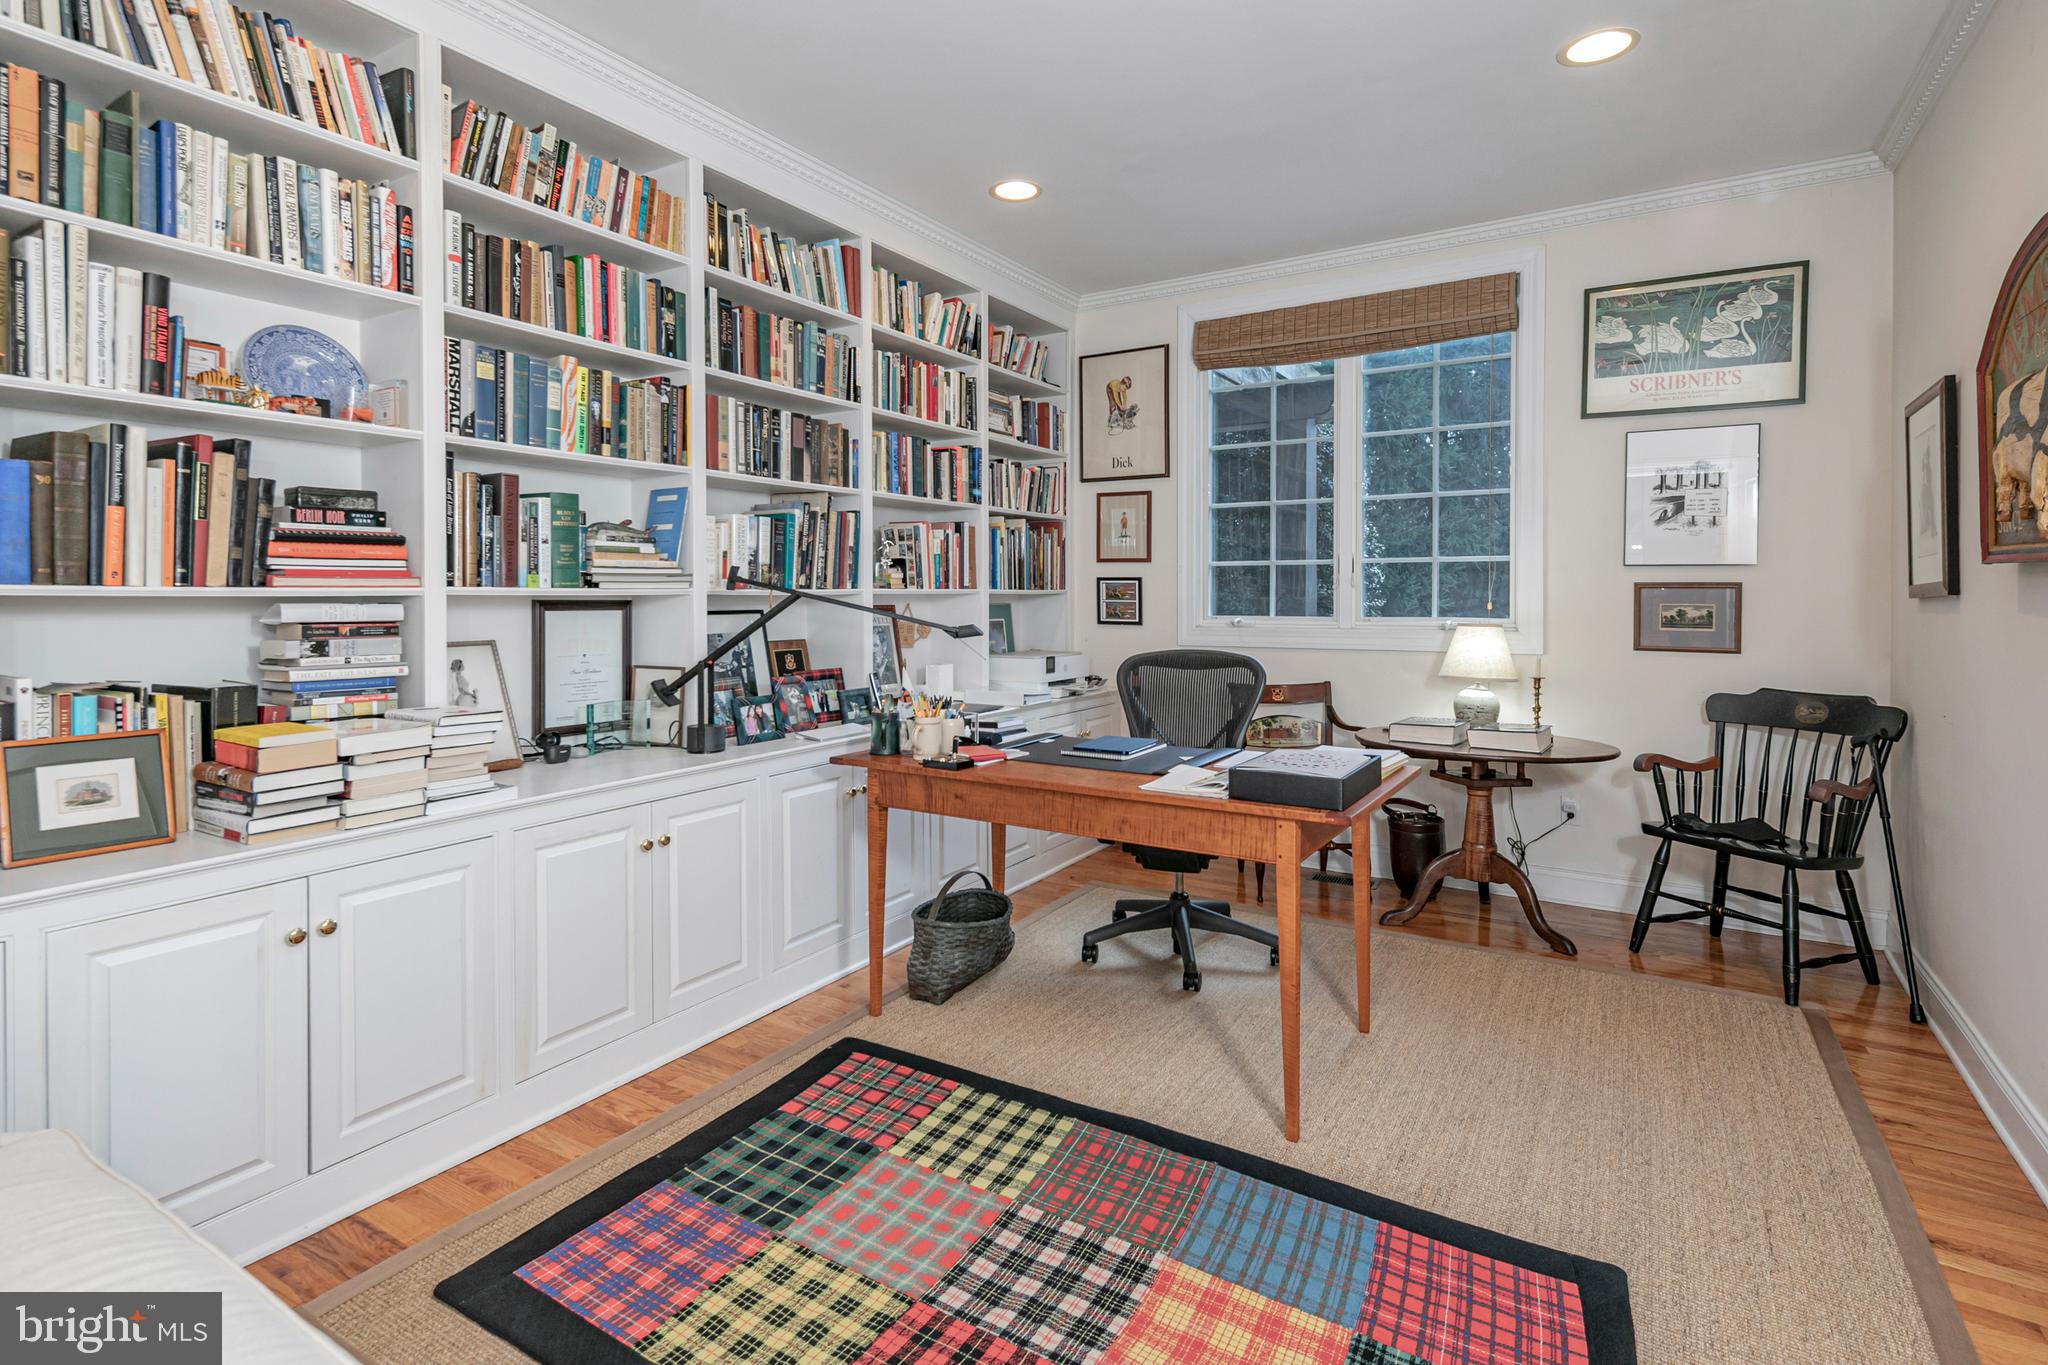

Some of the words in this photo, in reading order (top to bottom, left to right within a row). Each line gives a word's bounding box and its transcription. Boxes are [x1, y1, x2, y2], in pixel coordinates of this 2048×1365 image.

[80, 0, 90, 30] LORENCE
[281, 68, 290, 86] ART
[234, 165, 245, 208] GELLHORN
[554, 166, 564, 181] The
[552, 182, 562, 210] Italians
[341, 200, 352, 226] STREET
[342, 228, 353, 261] SMARTS
[467, 252, 473, 260] AI
[14, 280, 25, 294] THE
[98, 272, 106, 283] The
[14, 294, 26, 328] COMMON
[98, 284, 106, 318] Innovator's
[158, 307, 167, 326] VINO
[15, 327, 26, 342] LAW
[96, 320, 107, 358] Prescription
[156, 327, 167, 363] ITALIANO
[449, 338, 460, 432] MARSHALL
[1630, 369, 1743, 393] SCRIBNER'S
[114, 442, 124, 472] Princeton
[1112, 457, 1133, 469] Dick
[112, 472, 124, 502] University
[296, 508, 322, 524] BERLIN
[326, 508, 346, 524] NOIR
[35, 694, 49, 738] PRINC
